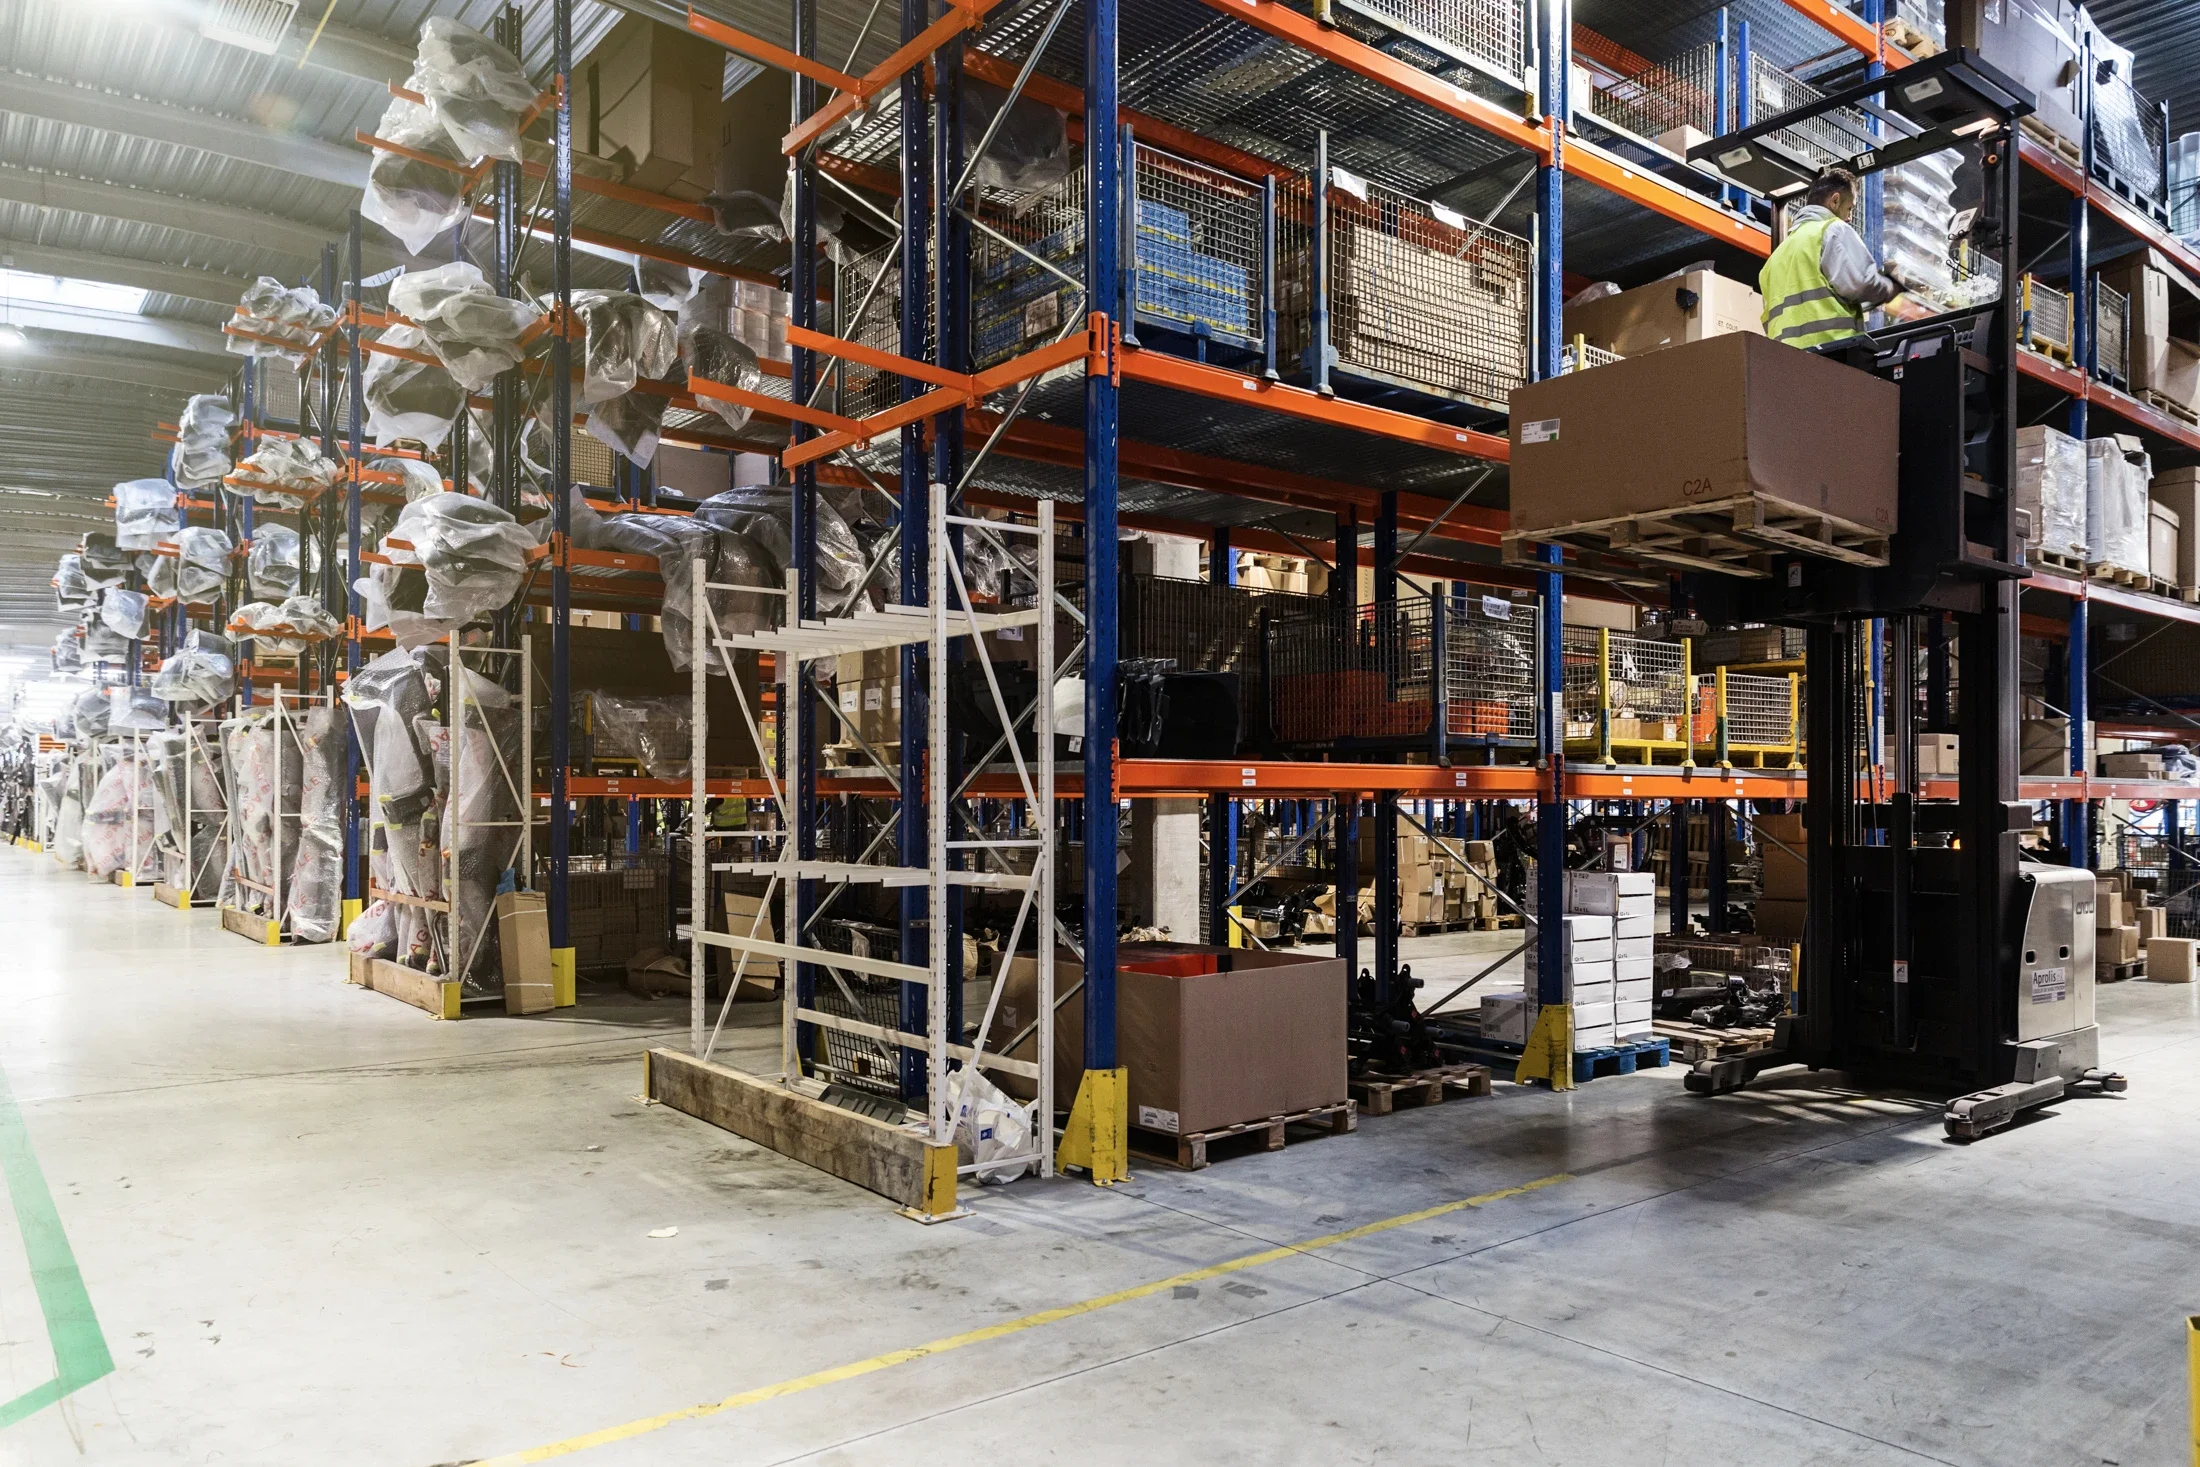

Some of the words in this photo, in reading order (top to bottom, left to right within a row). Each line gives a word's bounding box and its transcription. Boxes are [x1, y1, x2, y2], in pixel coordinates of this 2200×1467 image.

[1858, 154, 1875, 168] 11
[1682, 477, 1713, 497] C2A
[2033, 971, 2057, 986] Aprolis
